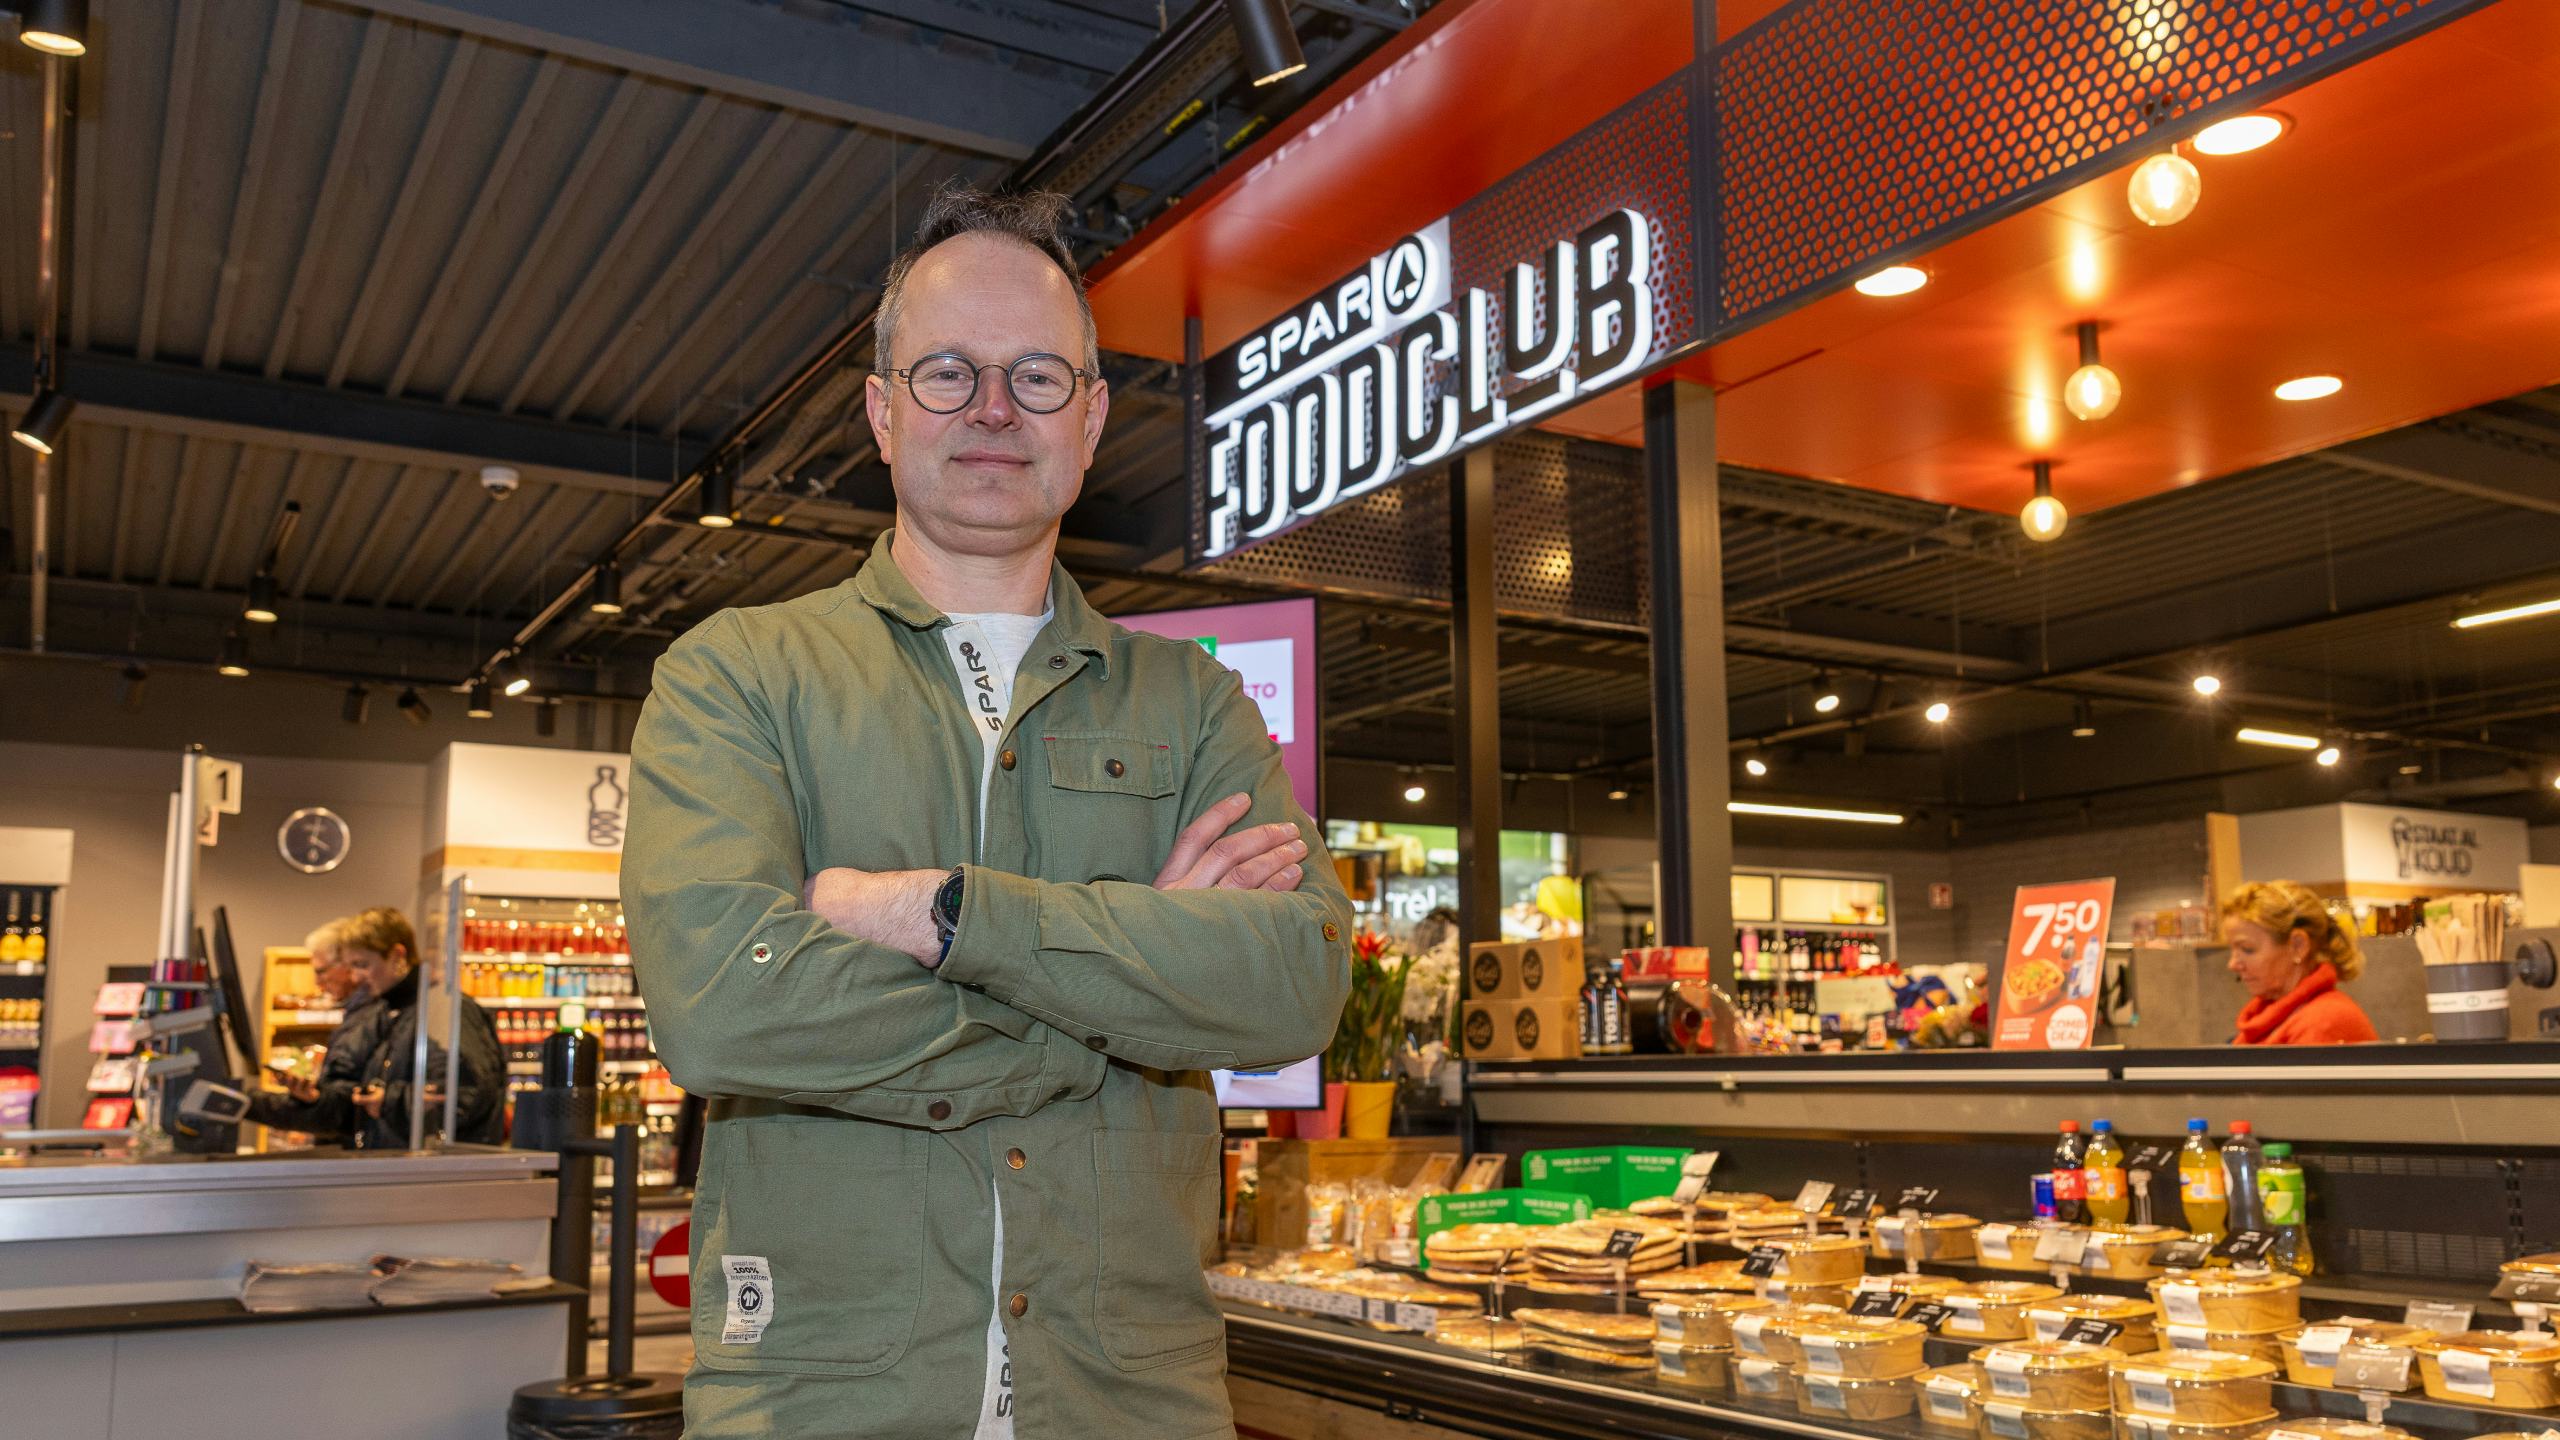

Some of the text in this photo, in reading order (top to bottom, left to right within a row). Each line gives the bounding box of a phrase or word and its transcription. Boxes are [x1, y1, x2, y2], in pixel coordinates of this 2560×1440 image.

[1238, 273, 1372, 390] SPAR
[1203, 207, 1654, 558] FOODCLUB
[966, 650, 1004, 732] SPAR
[216, 768, 229, 802] 1
